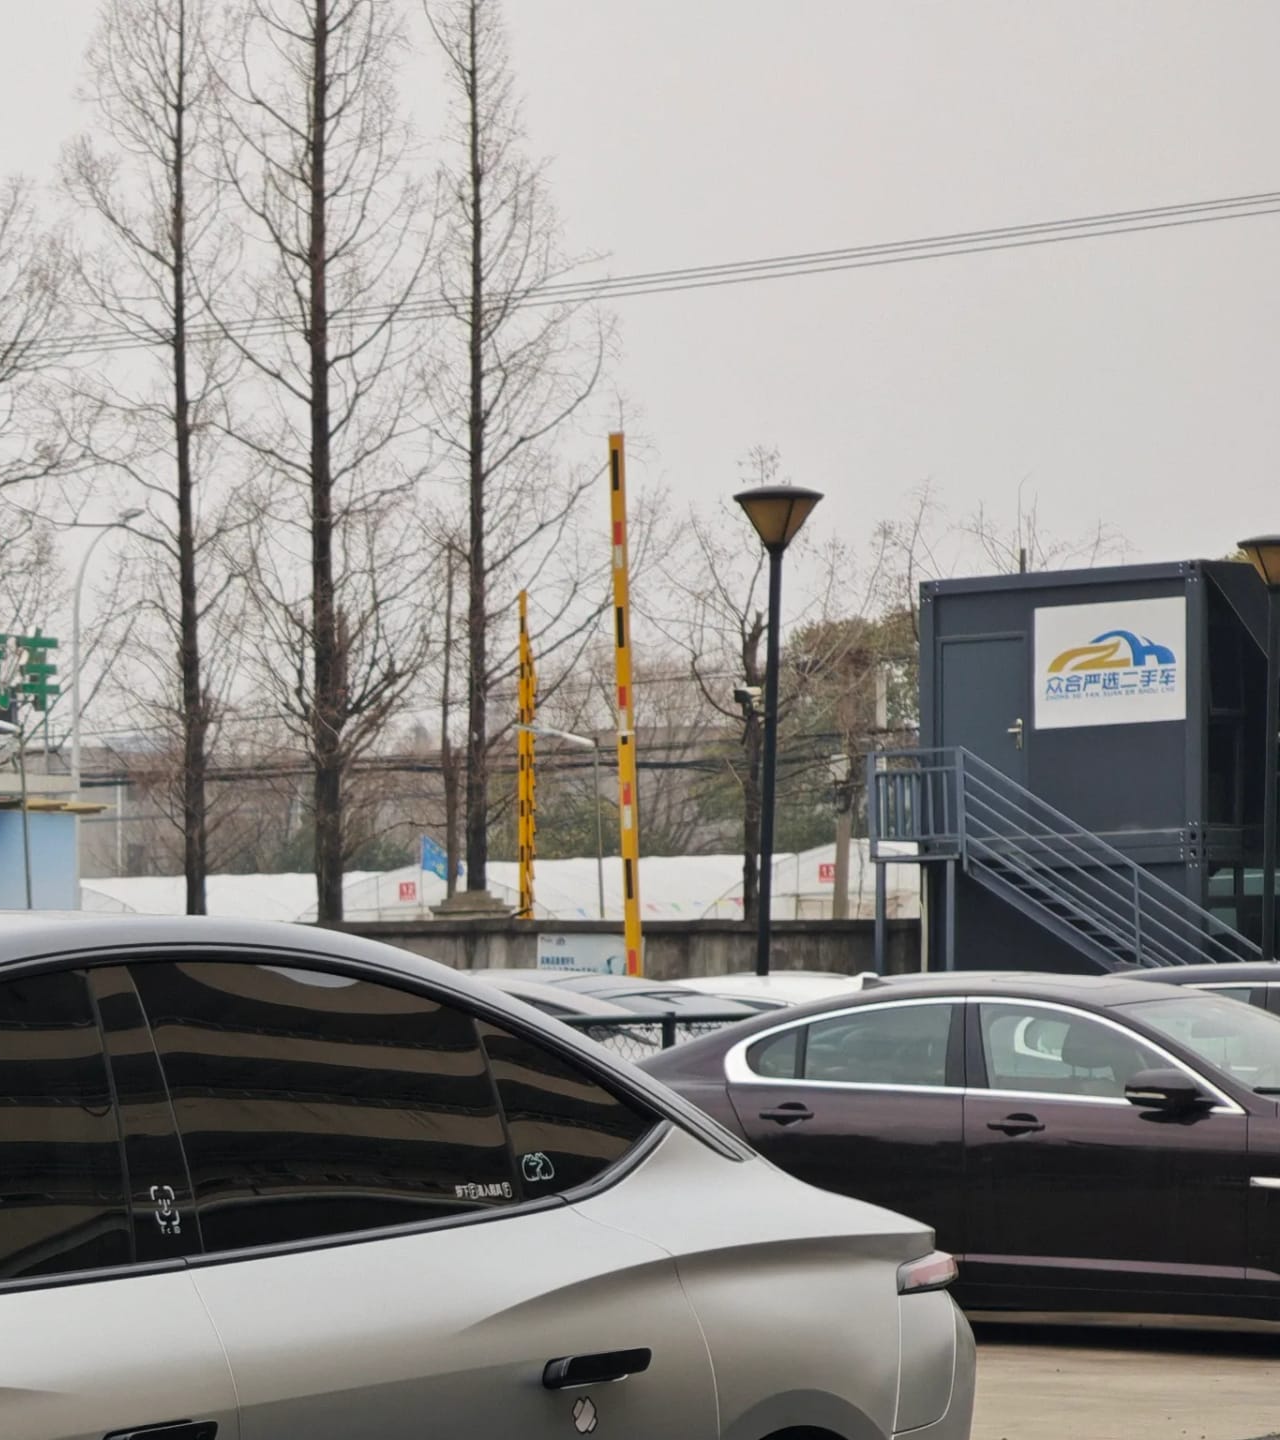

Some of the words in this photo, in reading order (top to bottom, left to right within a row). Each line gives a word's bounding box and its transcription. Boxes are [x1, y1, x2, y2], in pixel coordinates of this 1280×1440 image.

[1045, 668, 1177, 695] 众合严选二手车
